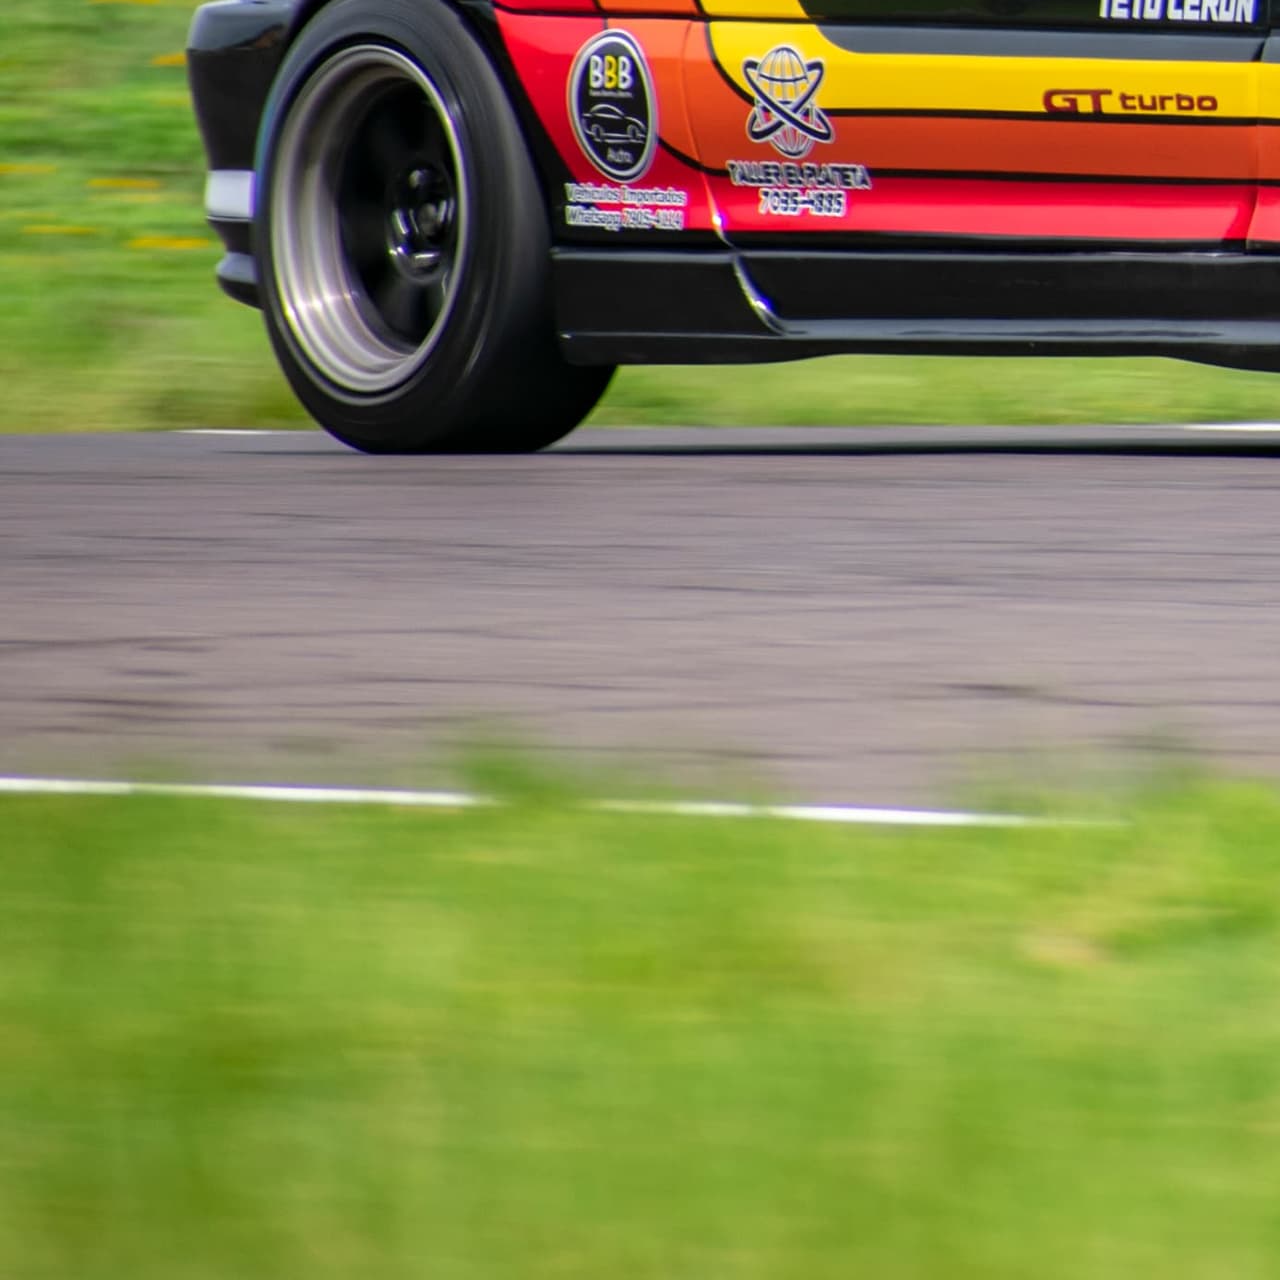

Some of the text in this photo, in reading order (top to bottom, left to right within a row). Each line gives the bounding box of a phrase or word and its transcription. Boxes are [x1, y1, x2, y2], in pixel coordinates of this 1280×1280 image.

[589, 55, 633, 89] BBB
[1042, 88, 1218, 114] GT turbo
